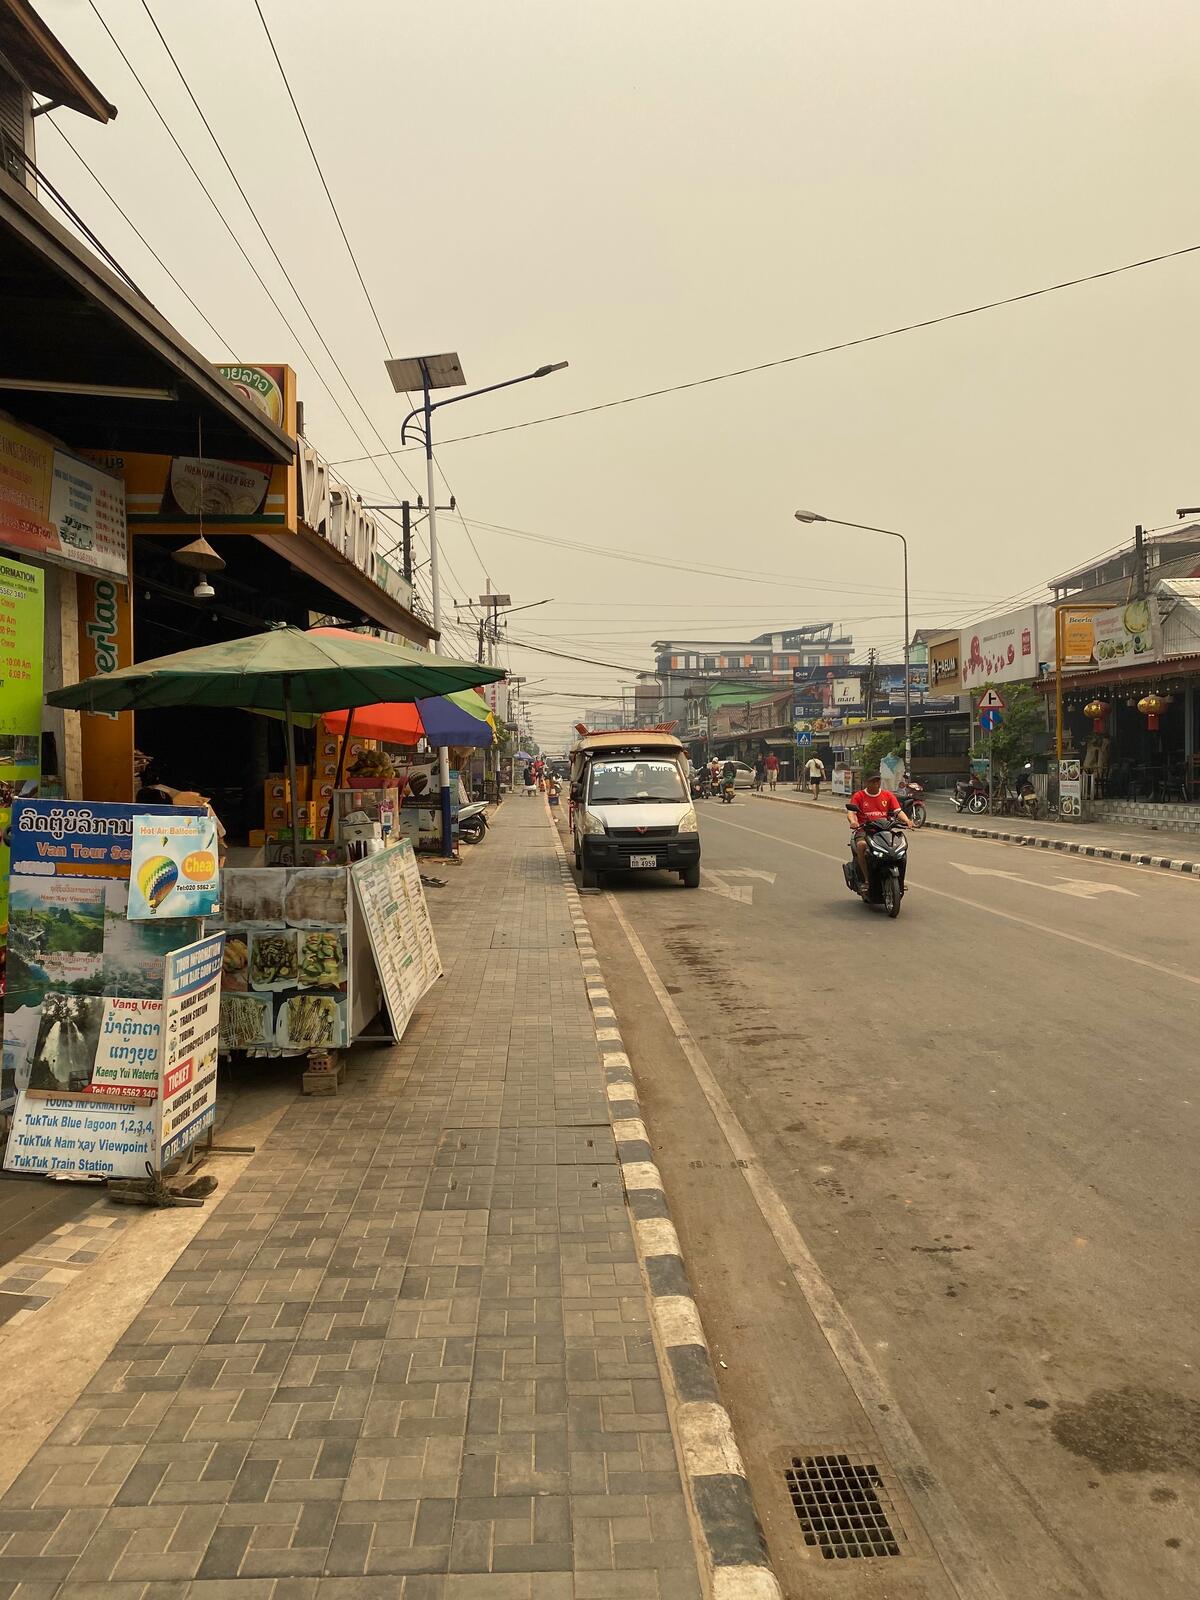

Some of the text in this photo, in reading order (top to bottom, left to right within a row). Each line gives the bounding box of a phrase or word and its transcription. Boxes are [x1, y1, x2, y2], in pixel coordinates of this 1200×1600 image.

[239, 478, 256, 489] BEER
[36, 842, 67, 857] Van
[71, 843, 107, 859] Tour
[112, 999, 138, 1011] Vang
[96, 1066, 118, 1080] Kaeng
[120, 1067, 131, 1078] Yui
[168, 1063, 190, 1092] TICKET
[92, 1086, 104, 1094] Tel:
[106, 1087, 120, 1096] 020
[122, 1088, 140, 1097] 5562
[25, 1114, 58, 1127] TukTuk
[61, 1116, 81, 1128] Blue
[84, 1117, 116, 1133] lagoon
[54, 1136, 75, 1149] Nam
[99, 1139, 147, 1154] Viewpoint
[51, 1157, 75, 1169] Train
[79, 1158, 113, 1171] Station
